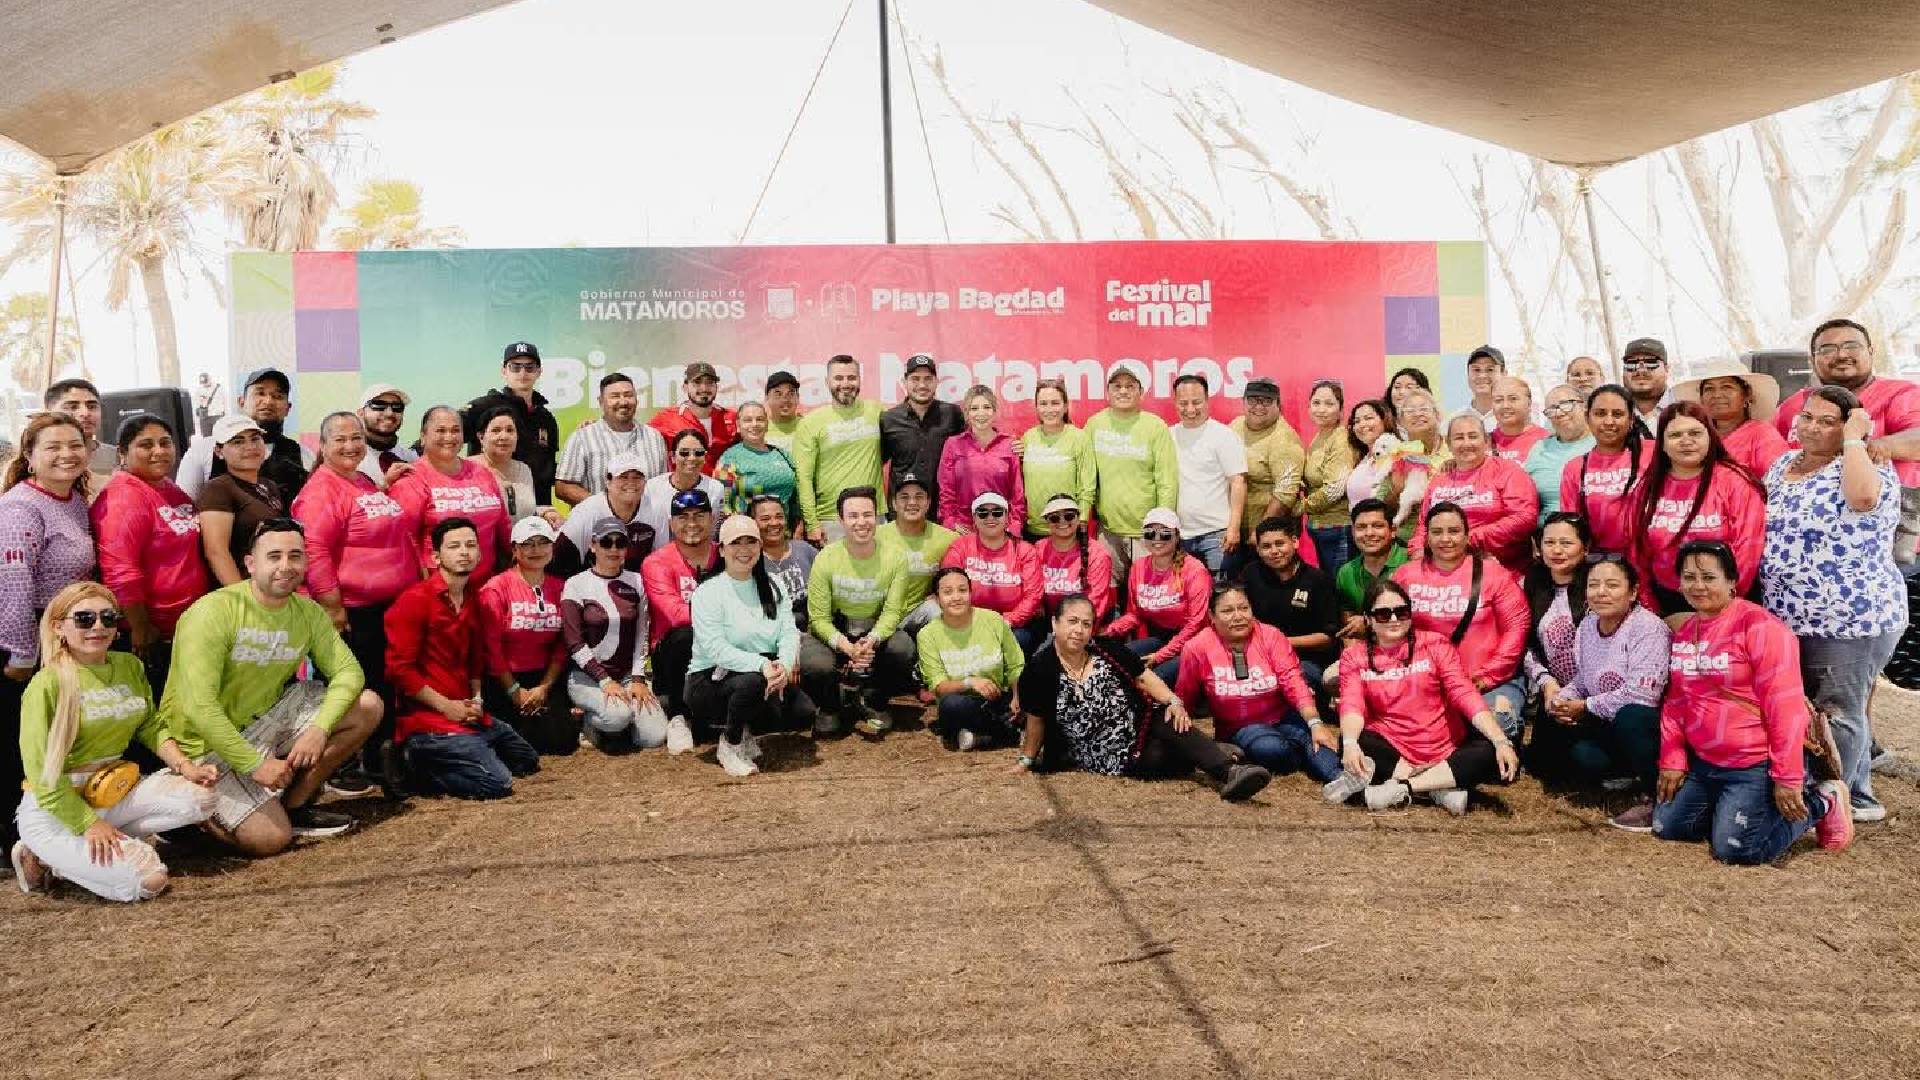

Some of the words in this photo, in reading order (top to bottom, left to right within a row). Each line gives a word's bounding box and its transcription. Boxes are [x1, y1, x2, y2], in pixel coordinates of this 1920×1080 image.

[580, 288, 645, 300] Gobierno
[653, 287, 722, 300] Municipal
[728, 289, 745, 298] de
[872, 288, 950, 316] Playa
[959, 287, 1064, 316] Bagdad
[1106, 278, 1211, 302] Festival
[580, 300, 745, 320] MATAMOROS
[1108, 308, 1135, 321] del
[1137, 302, 1211, 327] mar
